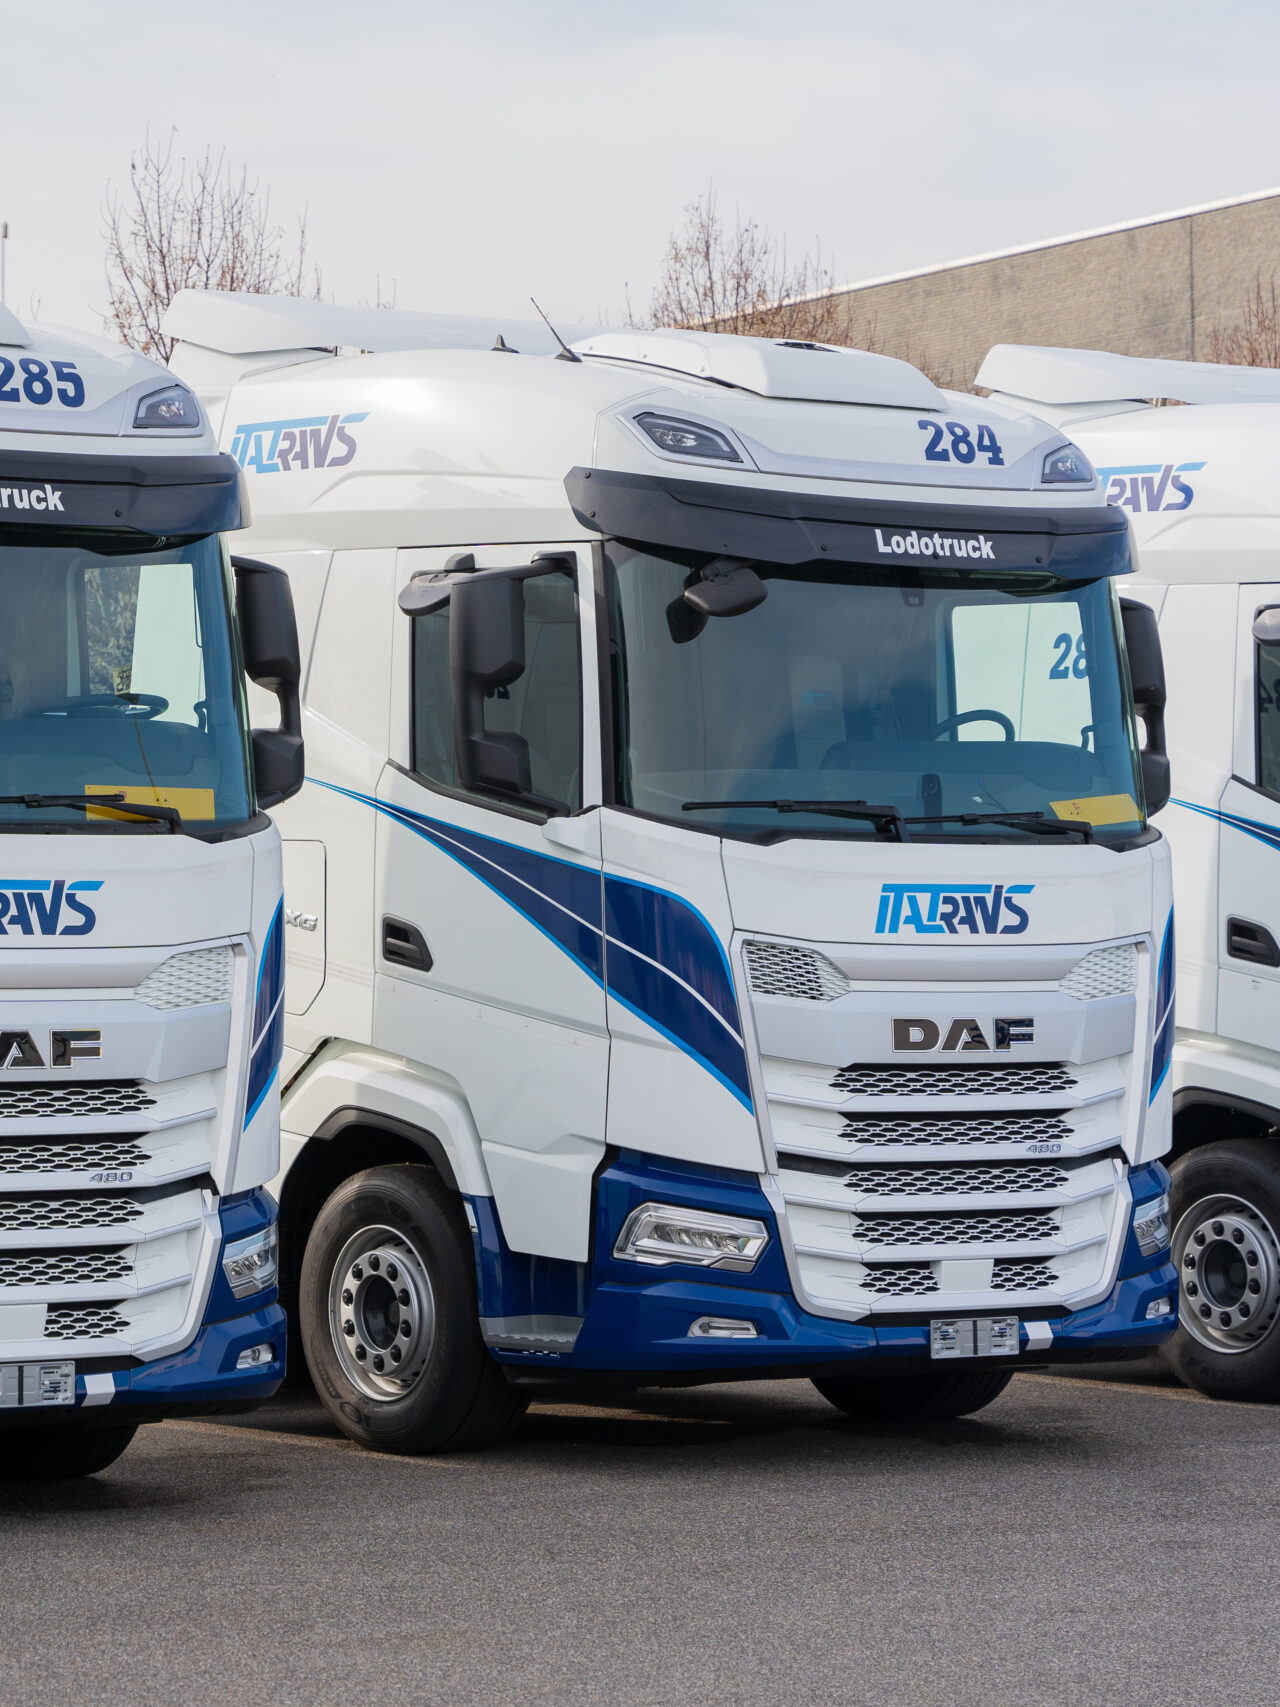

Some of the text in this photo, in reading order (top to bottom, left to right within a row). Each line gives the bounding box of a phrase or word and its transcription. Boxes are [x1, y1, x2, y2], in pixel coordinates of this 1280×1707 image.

[918, 419, 1006, 467] 284
[874, 529, 996, 560] Lodotruck
[1049, 632, 1089, 680] 28
[874, 883, 1036, 935] ITALTRANS
[890, 1017, 1035, 1053] DAF
[1025, 1143, 1062, 1155] 480
[88, 1170, 134, 1184] 480
